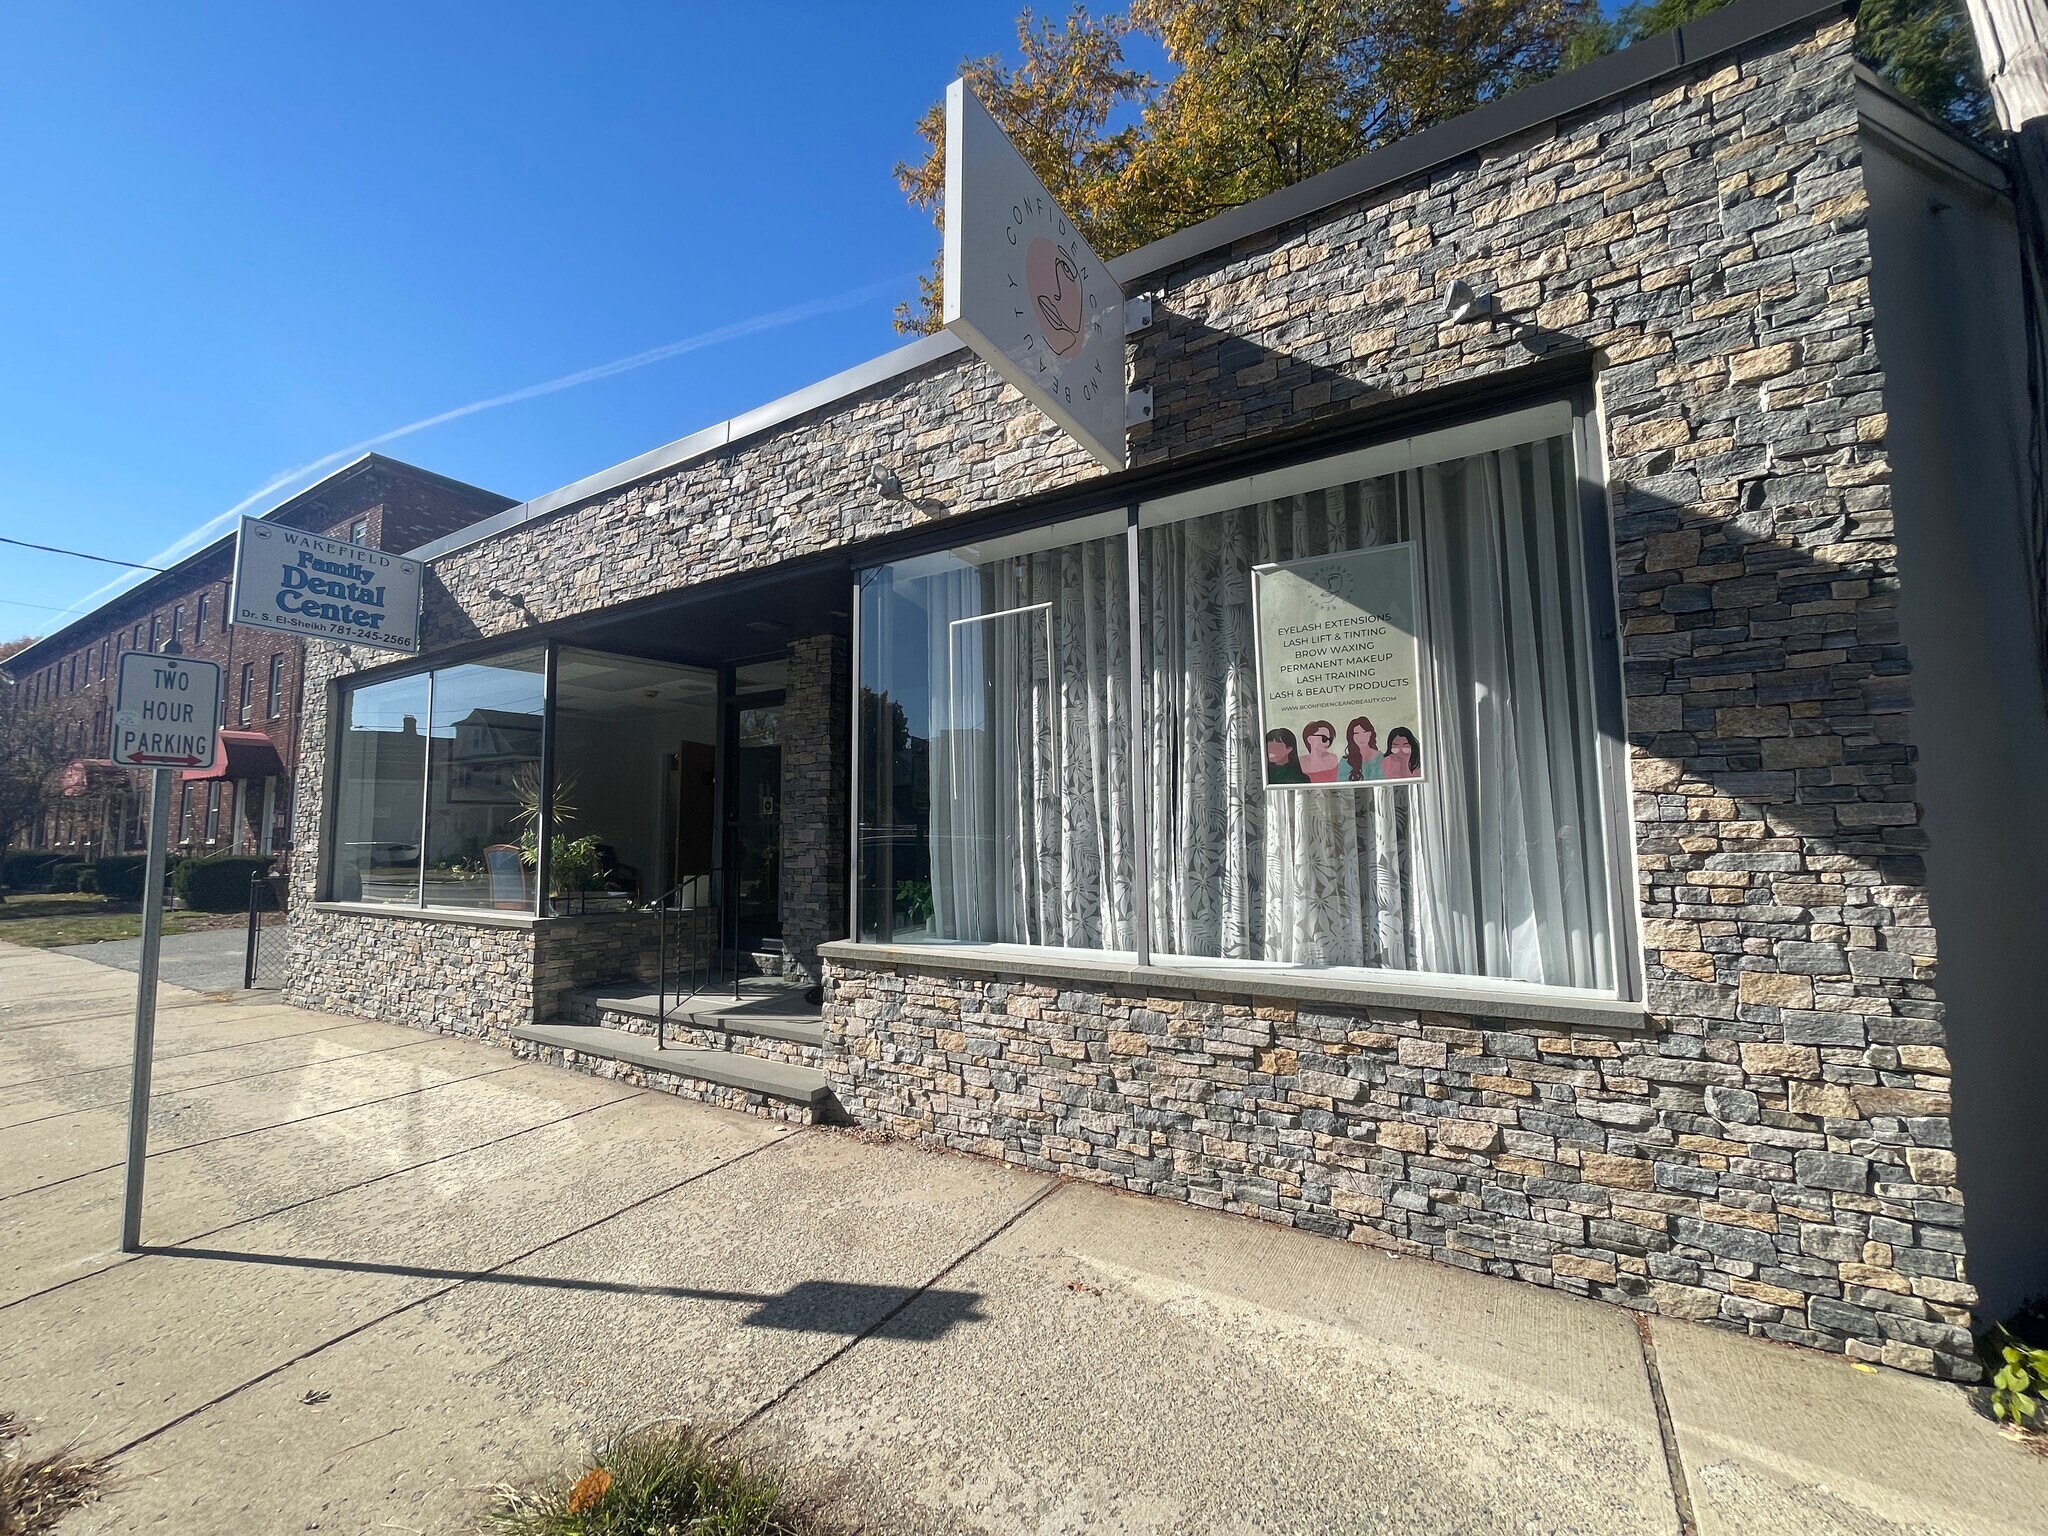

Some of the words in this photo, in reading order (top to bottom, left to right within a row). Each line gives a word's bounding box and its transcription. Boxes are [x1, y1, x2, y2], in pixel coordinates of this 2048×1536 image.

[1006, 196, 1102, 335] CONFIDENCE
[1007, 273, 1071, 403] BEAUTY
[1083, 358, 1102, 401] AND
[284, 532, 390, 567] WAKEFIELD
[297, 550, 376, 585] Family
[281, 564, 386, 608] Dental
[275, 589, 386, 630] Center
[242, 609, 258, 620] Dr.
[261, 612, 273, 622] S.
[276, 615, 327, 632] El-Sheikh
[330, 623, 412, 647] 781-245-2566
[1278, 622, 1322, 636] EYELASH
[1324, 612, 1392, 629] EXTENSIONS
[1283, 637, 1309, 648] LASH
[1311, 633, 1332, 644] LIFT
[1334, 633, 1342, 641] &
[1343, 626, 1387, 639] TINTING
[1295, 647, 1327, 659] BROW
[1329, 641, 1375, 654] WAXING
[1280, 658, 1344, 674] PERMANENT
[1346, 652, 1393, 666] MAKEUP
[153, 668, 189, 692] TWO
[1296, 674, 1323, 685] LASH
[1324, 668, 1376, 681] TRAINING
[1269, 690, 1294, 701] LASH
[1296, 689, 1304, 698] &
[1305, 684, 1346, 697] BEAUTY
[1348, 678, 1410, 692] PRODUCTS
[142, 700, 194, 723] HOUR
[124, 731, 206, 755] PARKING
